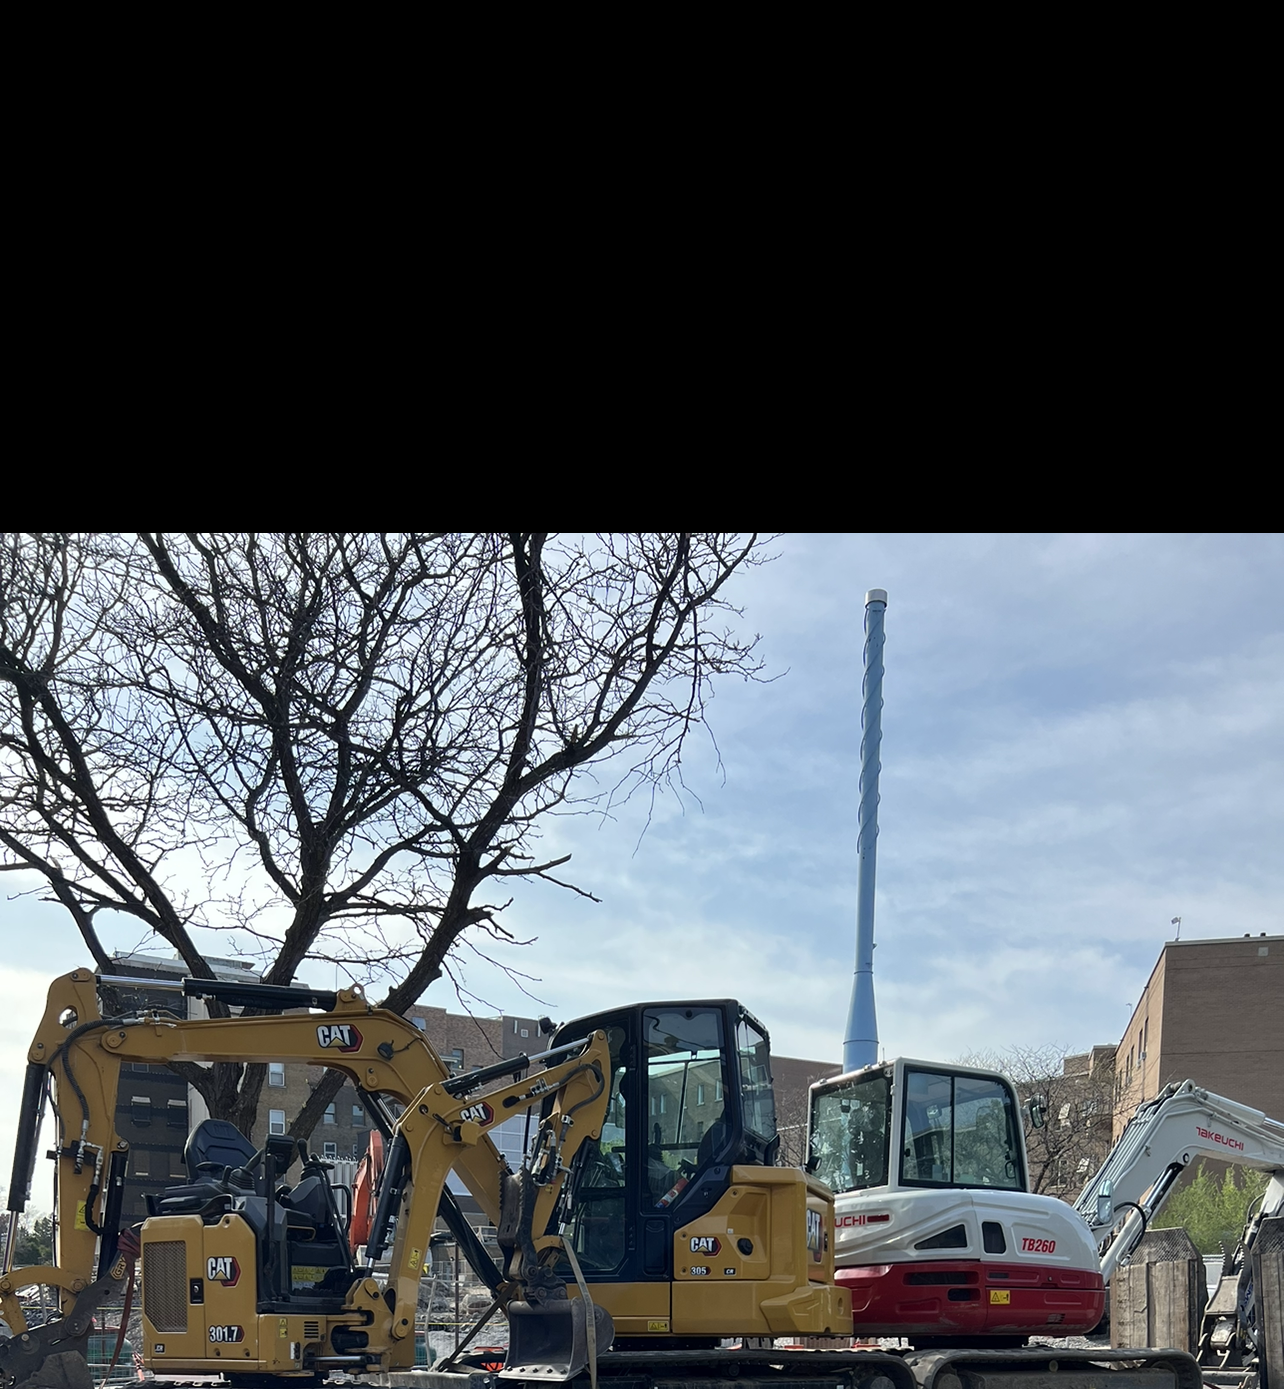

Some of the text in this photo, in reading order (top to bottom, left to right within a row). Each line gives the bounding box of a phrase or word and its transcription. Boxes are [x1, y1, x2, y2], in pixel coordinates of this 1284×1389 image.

[317, 1025, 351, 1048] CAT
[460, 1102, 487, 1122] CAT
[806, 1209, 821, 1249] CAT
[834, 1215, 865, 1227] UCHI
[690, 1236, 714, 1252] CAT
[1022, 1237, 1056, 1253] TB260
[207, 1257, 233, 1280] CAT
[690, 1267, 707, 1275] 305
[209, 1325, 238, 1342] 301.7
